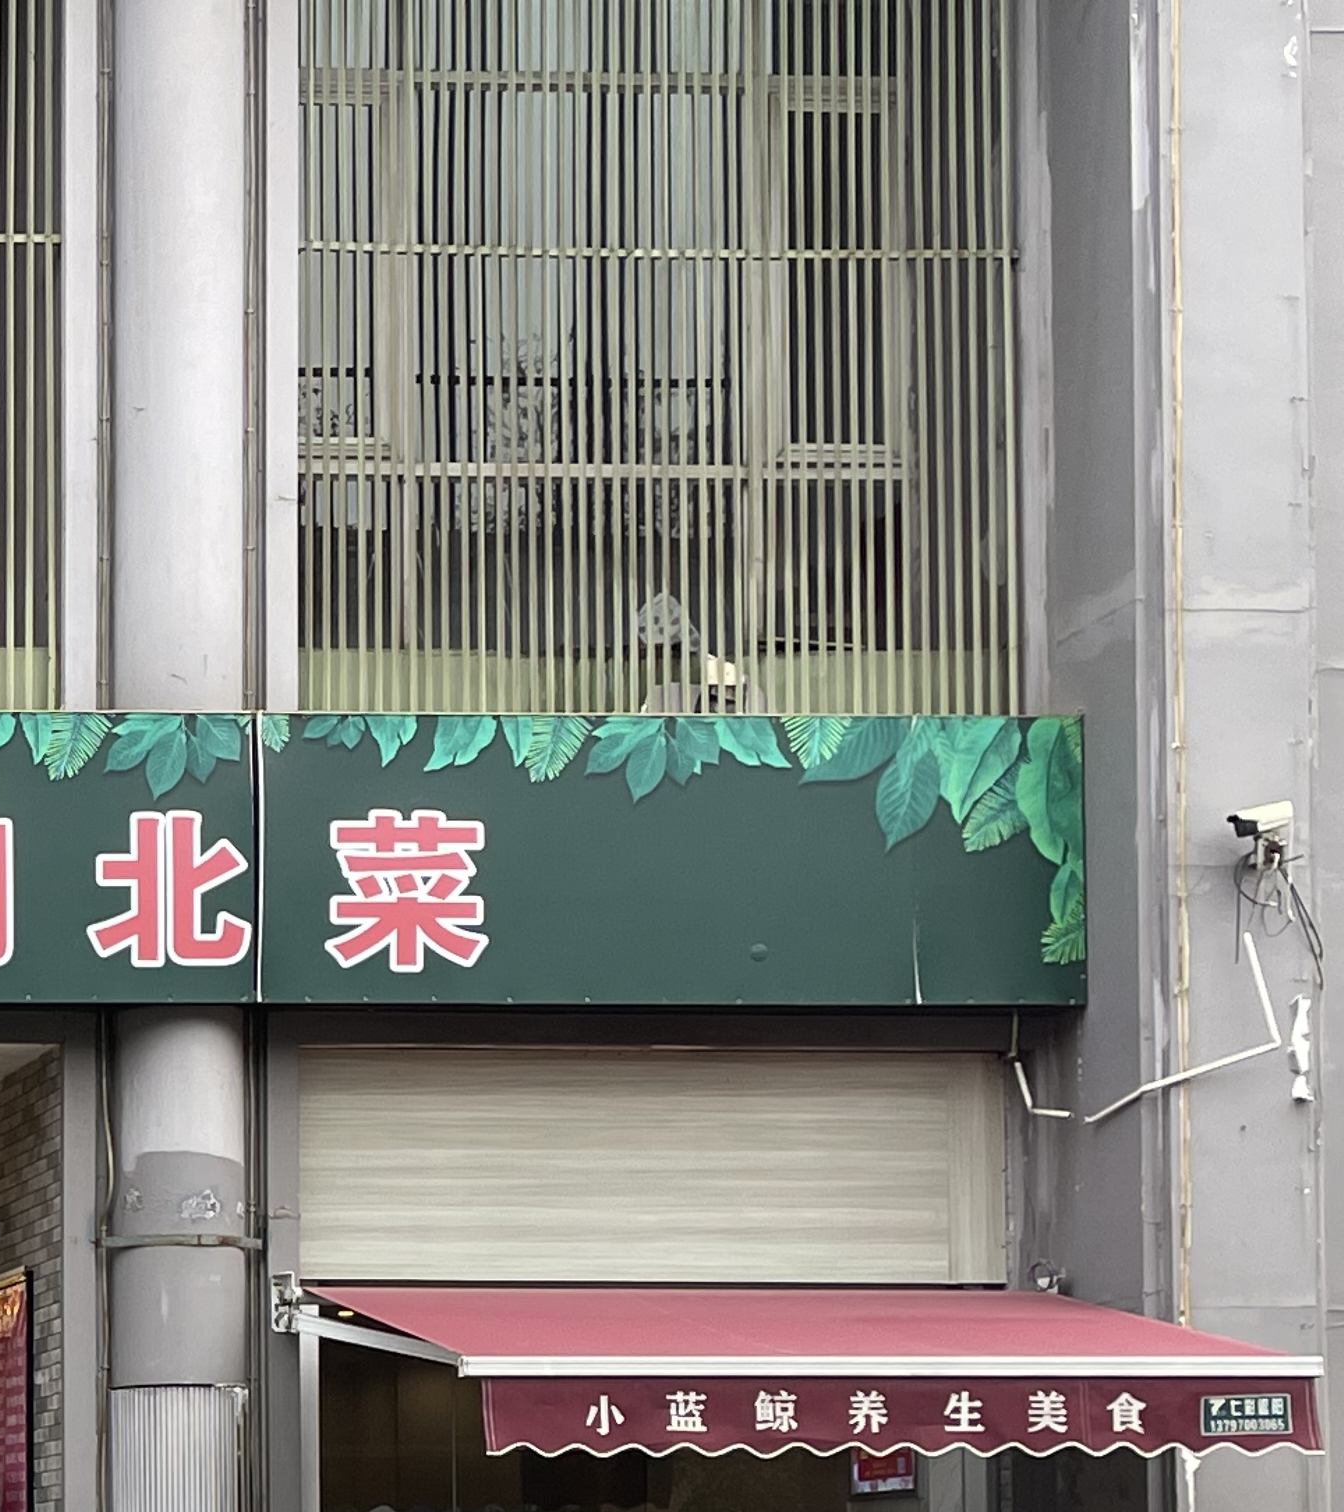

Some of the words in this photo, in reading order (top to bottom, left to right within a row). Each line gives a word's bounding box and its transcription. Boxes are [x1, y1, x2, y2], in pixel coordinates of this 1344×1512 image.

[584, 1391, 1148, 1436] 小蓝鲸养生美食
